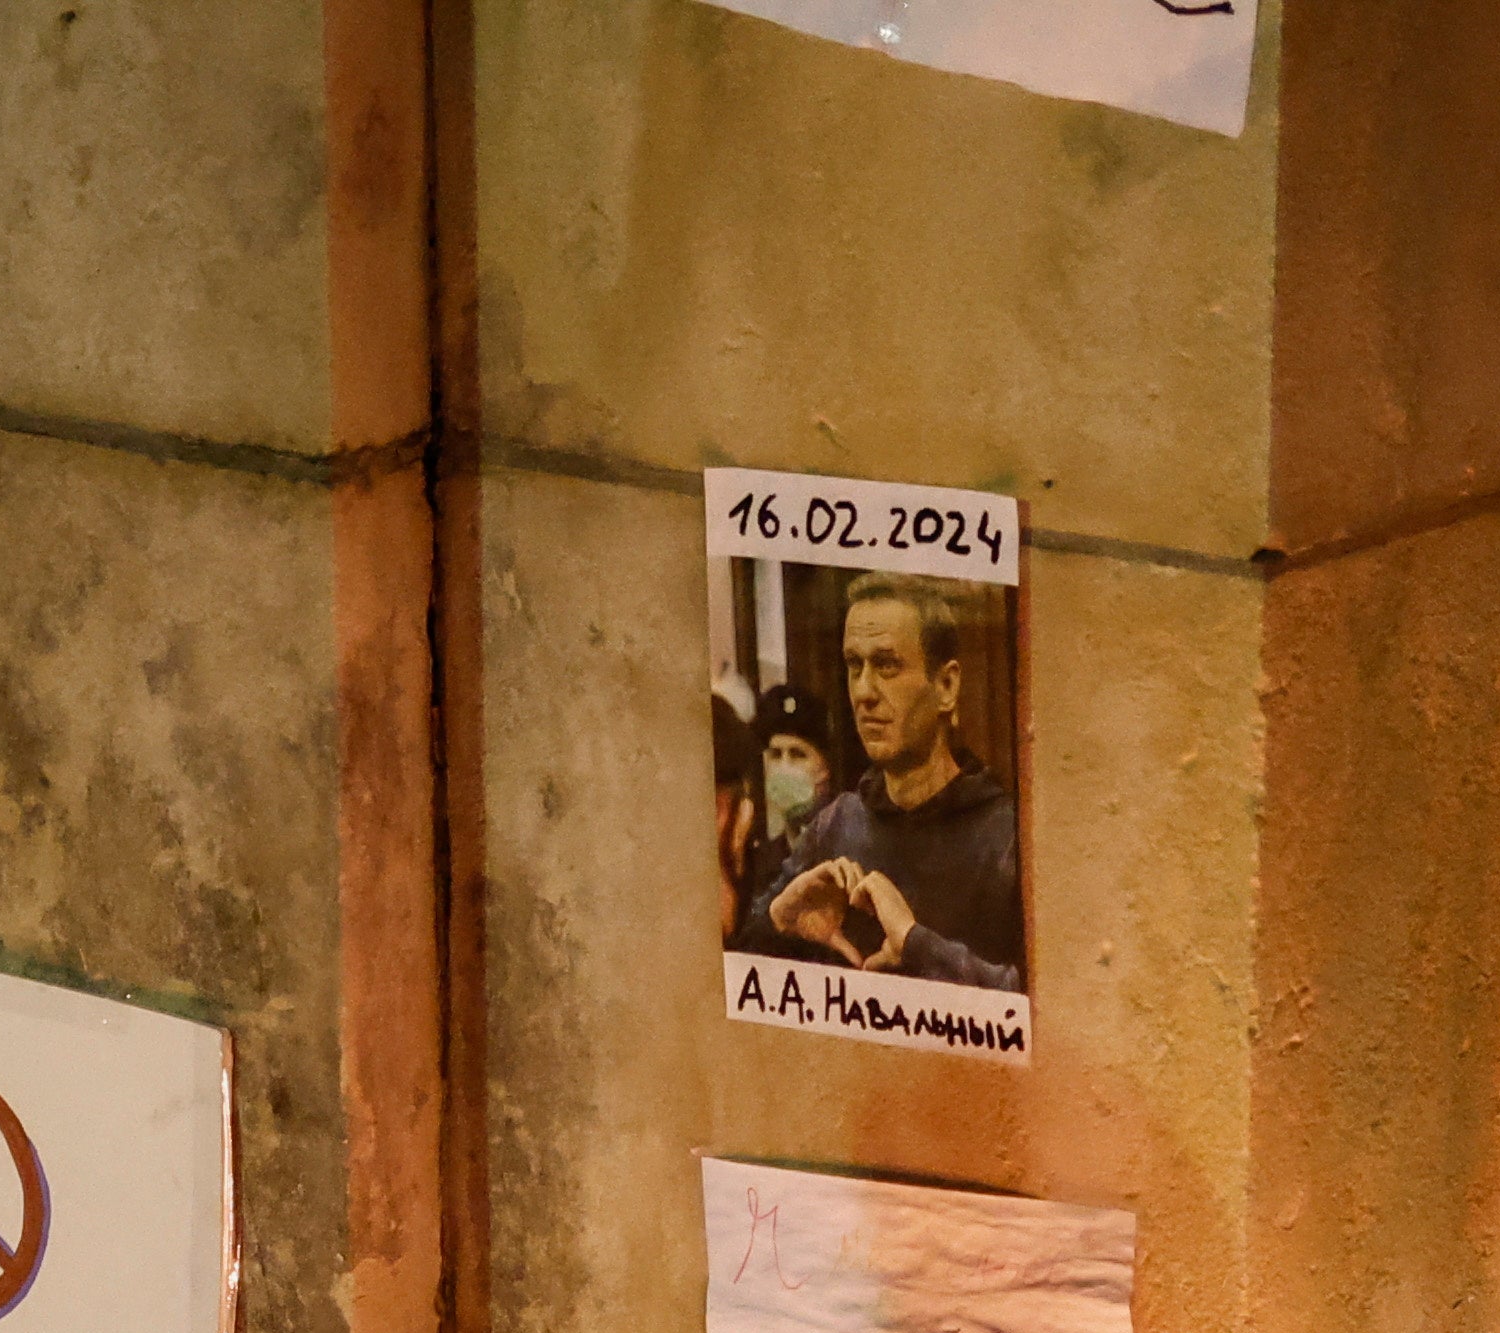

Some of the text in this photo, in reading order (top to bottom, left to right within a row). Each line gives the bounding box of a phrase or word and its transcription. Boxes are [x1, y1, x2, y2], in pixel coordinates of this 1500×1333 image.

[727, 492, 1003, 564] 16.02.2024
[737, 967, 1026, 1054] А.А. Навальный
